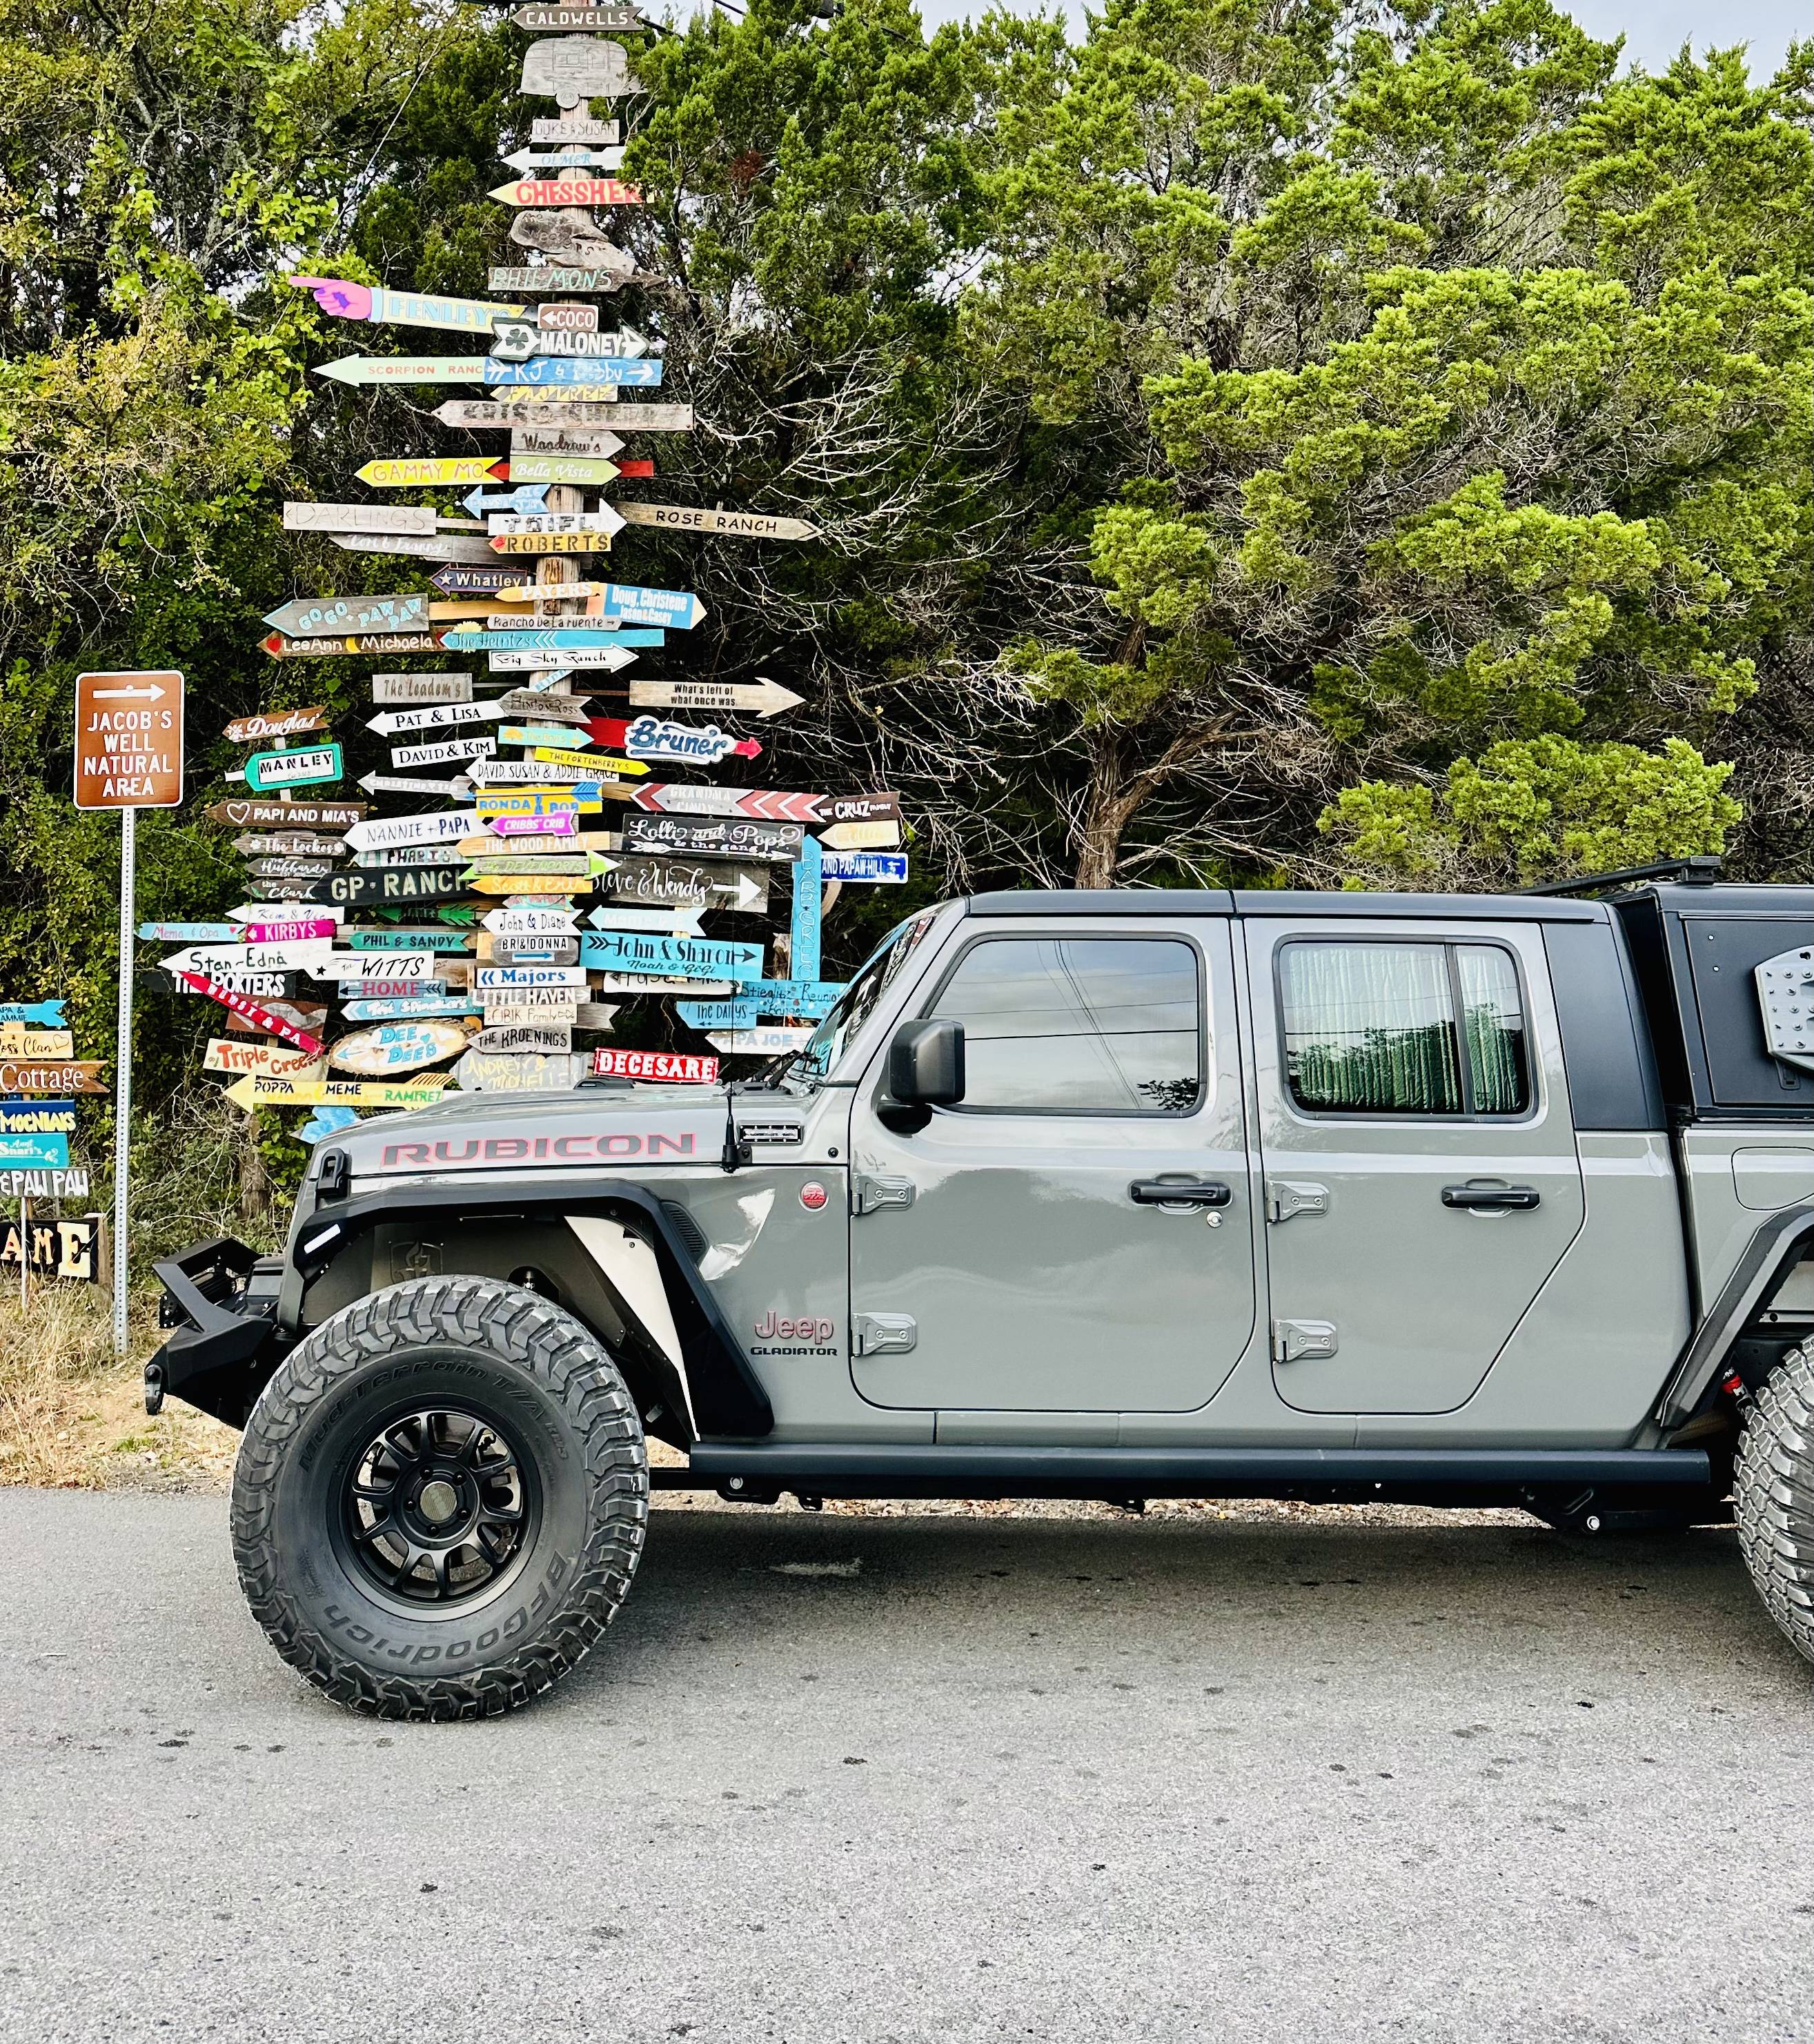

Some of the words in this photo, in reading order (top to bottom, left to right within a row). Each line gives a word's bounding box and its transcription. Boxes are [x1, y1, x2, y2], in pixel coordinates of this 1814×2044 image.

[526, 11, 629, 26] CALDWELLS
[535, 121, 567, 136] DUKE
[580, 121, 615, 136] SUSAN
[556, 310, 595, 328] COCO
[540, 332, 624, 356] MALONEY
[368, 366, 435, 375] SCORPION
[448, 366, 484, 374] RANC
[515, 361, 549, 382] KJ
[522, 432, 602, 453] Woodrow's
[373, 463, 443, 481] GAMMY
[454, 462, 483, 478] MO
[515, 462, 550, 477] Bella
[554, 462, 593, 478] Vista
[295, 504, 426, 530] DARLINGS
[656, 510, 703, 526] ROSE
[716, 519, 778, 533] RANCH
[507, 535, 609, 553] ROBERTS
[456, 573, 522, 588] Whatley
[611, 585, 640, 608] Doug,
[298, 602, 348, 631] GOGO
[493, 617, 534, 628] Rancho
[566, 616, 603, 628] Fuente
[361, 634, 434, 651] Michaela
[495, 653, 521, 666] Big
[528, 652, 558, 664] Sky
[562, 651, 607, 662] Ranch
[384, 680, 403, 697] The
[674, 684, 704, 695] What's
[707, 686, 722, 695] left
[724, 686, 733, 695] of
[671, 695, 692, 704] what
[694, 697, 716, 706] once
[87, 710, 173, 732] JACOB'S
[395, 715, 422, 728] PAT
[431, 711, 444, 723] &
[452, 707, 481, 720] LISA
[103, 733, 155, 753] WELL
[629, 720, 729, 757] Bruner
[400, 748, 444, 764] DAVID
[446, 744, 459, 757] &
[463, 742, 491, 755] KIM
[549, 752, 565, 761] THE
[83, 754, 173, 776] NATURAL
[260, 753, 332, 774] MANLEY
[509, 764, 539, 779] SUSAN
[540, 765, 551, 779] &
[102, 776, 155, 797] AREA
[478, 800, 531, 811] RONDA
[834, 801, 871, 820] CRUZ
[253, 808, 284, 821] PAPI
[287, 809, 318, 822] AND
[322, 810, 359, 823] MIA'S
[544, 818, 565, 828] CRIB
[366, 822, 424, 844] NANNIE
[691, 823, 727, 841] and
[484, 838, 505, 852] THE
[509, 837, 544, 851] WOOD
[546, 835, 589, 851] FAMILY
[691, 840, 716, 849] the
[821, 857, 838, 875] AND
[262, 880, 277, 889] the
[331, 875, 364, 901] GP
[500, 912, 523, 931] John
[527, 913, 537, 930] &
[541, 913, 566, 930] Diane
[199, 926, 219, 939] Opa
[265, 922, 317, 942] KIRBYS
[363, 936, 390, 947] PHIL
[395, 937, 404, 947] &
[409, 935, 456, 948] SANDY
[530, 937, 567, 949] DONNA
[612, 937, 655, 959] John
[659, 940, 673, 961] &
[676, 940, 736, 966] Sharon
[361, 957, 426, 977] WITTS
[500, 969, 566, 986] Majors
[361, 980, 420, 997] HOME
[526, 988, 576, 1006] HAVEN
[379, 1026, 417, 1044] DEE
[478, 1032, 497, 1048] THE
[501, 1027, 568, 1049] KROENINGS
[761, 1033, 793, 1047] JOE
[23, 1035, 52, 1056] Clan
[217, 1044, 269, 1071] Triple
[598, 1052, 714, 1080] DECESARE
[1, 1063, 83, 1093] Cottage
[254, 1081, 295, 1094] POPPA
[325, 1083, 362, 1095] MEME
[384, 1089, 442, 1103] RAMIREZ
[382, 1132, 696, 1167] RUBICON
[11, 1170, 49, 1196] PAW
[52, 1169, 89, 1197] PAW
[755, 1310, 834, 1345] Jeep
[750, 1347, 838, 1356] GLADIATOR
